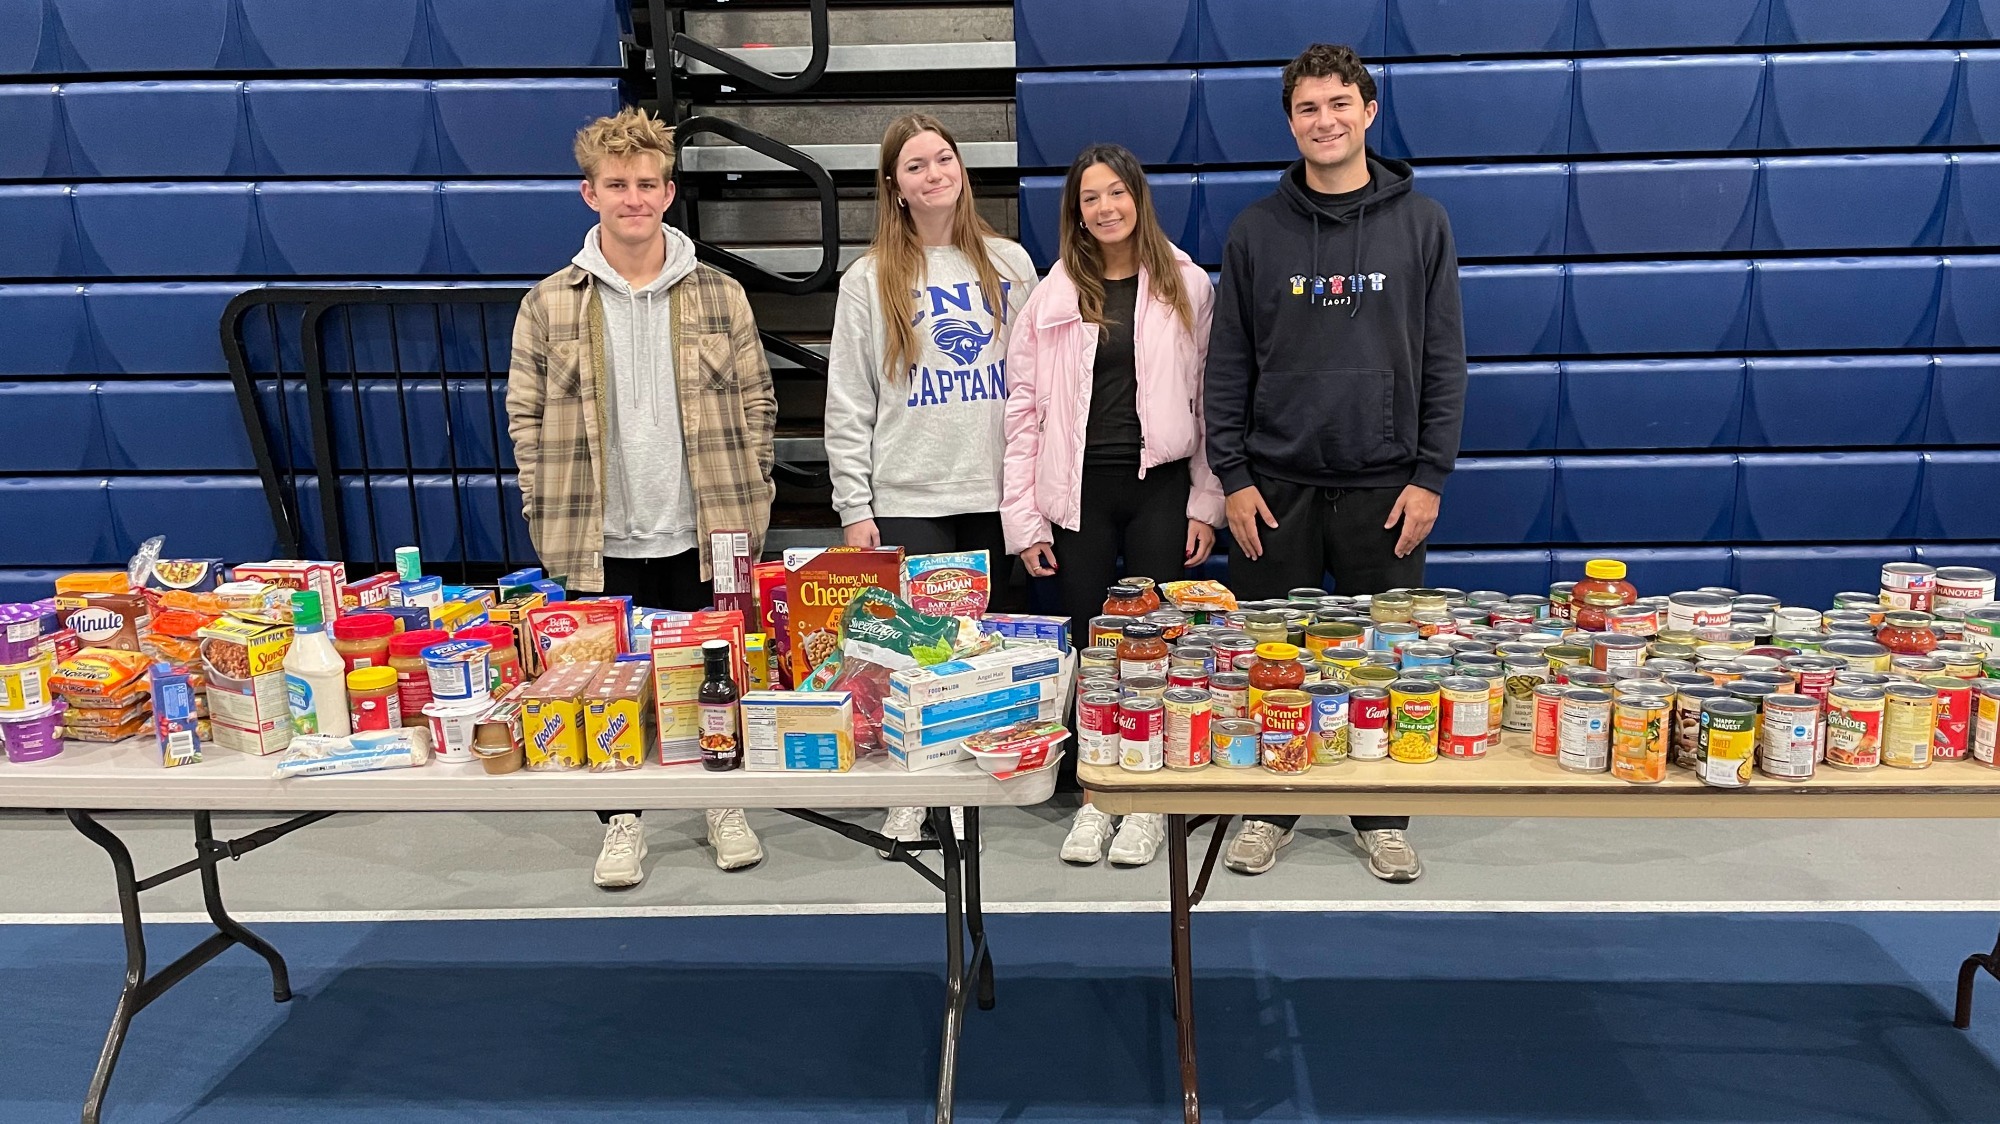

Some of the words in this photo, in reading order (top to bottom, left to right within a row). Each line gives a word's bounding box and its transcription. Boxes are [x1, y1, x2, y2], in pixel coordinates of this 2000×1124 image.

[920, 557, 951, 568] FAMILY
[829, 573, 858, 586] Honey
[861, 573, 878, 584] Nut
[926, 578, 972, 594] IDAHOAN
[360, 585, 389, 607] HELP
[800, 581, 860, 606] Cheer
[1937, 588, 1981, 598] HANOVER
[773, 600, 789, 614] TOA
[67, 613, 122, 633] Minute
[549, 618, 571, 627] Betty
[544, 625, 576, 634] Crocker
[250, 636, 266, 647] TWIN
[268, 632, 284, 642] PACK
[255, 648, 283, 672] Stove
[977, 672, 992, 682] Angel
[993, 670, 1004, 678] Hair
[1325, 665, 1347, 679] CK'S
[1262, 703, 1303, 719] Hormel
[1119, 715, 1136, 730] bell's
[1266, 717, 1295, 730] Chili
[1400, 722, 1415, 730] Diced
[1713, 721, 1741, 730] HARVEST
[1714, 717, 1737, 725] HAPPY
[926, 752, 939, 760] FOOD
